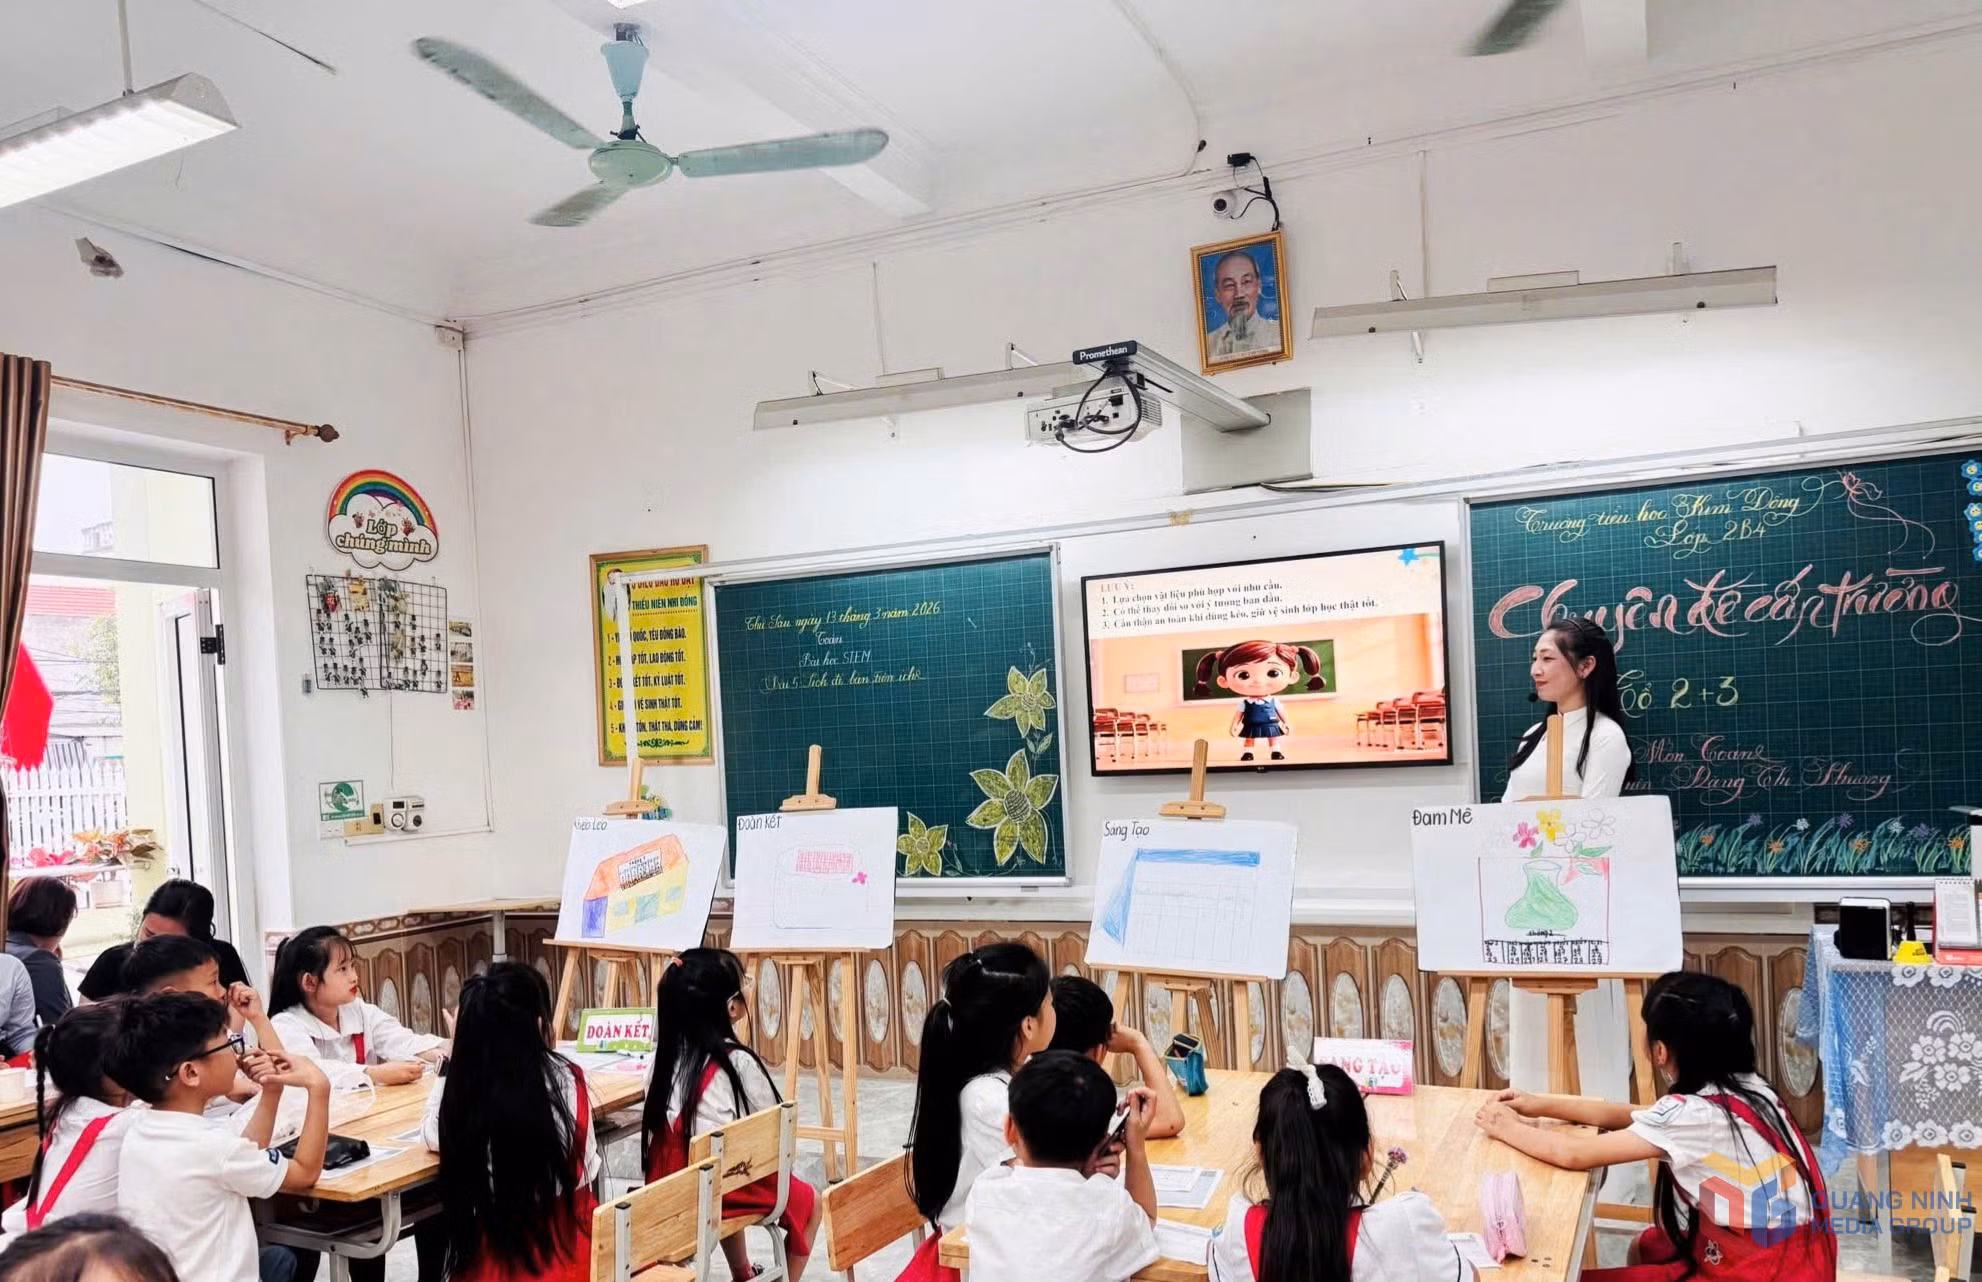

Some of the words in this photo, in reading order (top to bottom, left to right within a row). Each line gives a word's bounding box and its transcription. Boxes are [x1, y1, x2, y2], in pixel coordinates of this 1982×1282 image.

[1080, 346, 1128, 360] Promethean
[1671, 492, 1732, 519] Kim
[366, 518, 398, 538] Lớp
[1722, 520, 1766, 540] 2B4
[336, 532, 388, 554] chúng
[388, 536, 432, 554] mình
[1132, 594, 1152, 604] chọn
[1154, 590, 1167, 601] vật
[1170, 590, 1186, 600] liệu
[1208, 586, 1224, 598] hợp
[1244, 583, 1260, 592] nhu
[1264, 579, 1282, 590] cầu.
[632, 597, 650, 610] THIẾU
[651, 597, 666, 609] NIÊN
[668, 598, 678, 608] NHI
[680, 594, 698, 606] ĐỒNG
[1114, 606, 1125, 616] Có
[1142, 603, 1160, 614] thay
[1262, 592, 1282, 602] đầu.
[1134, 616, 1152, 627] thận
[1190, 612, 1204, 622] khi
[1268, 606, 1278, 617] vệ
[1280, 604, 1300, 614] sinh
[1302, 603, 1318, 614] lớp
[1320, 602, 1337, 612] học
[1340, 600, 1359, 611] thật
[1362, 596, 1378, 608] tốt.
[795, 614, 822, 634] ngày
[826, 610, 836, 623] 13
[839, 606, 871, 629] tháng
[873, 608, 882, 620] 3
[912, 601, 941, 616] 2026
[1488, 578, 1687, 652] Chyên
[650, 629, 659, 640] YÊU
[815, 630, 843, 646] Toán
[608, 656, 612, 666] 2
[650, 653, 660, 663] LAO
[660, 652, 674, 665] ĐỘNG
[675, 648, 686, 662] TỐT.
[842, 650, 872, 664] STEM
[662, 674, 673, 688] LUẬT
[674, 671, 686, 685] TỐT.
[638, 697, 644, 712] VỆ
[645, 698, 658, 709] SINH
[658, 696, 670, 712] THẬT
[672, 695, 682, 708] TỐT.
[648, 720, 660, 734] THẬT
[738, 816, 762, 830] Đoàn
[1412, 808, 1448, 826] Đam
[1449, 807, 1474, 825] Mê
[1104, 821, 1128, 842] Sáng
[1132, 821, 1150, 838] Tạo
[587, 1021, 622, 1038] ĐOÀN
[624, 1020, 649, 1038] KẾT
[1368, 1058, 1400, 1079] TẠO
